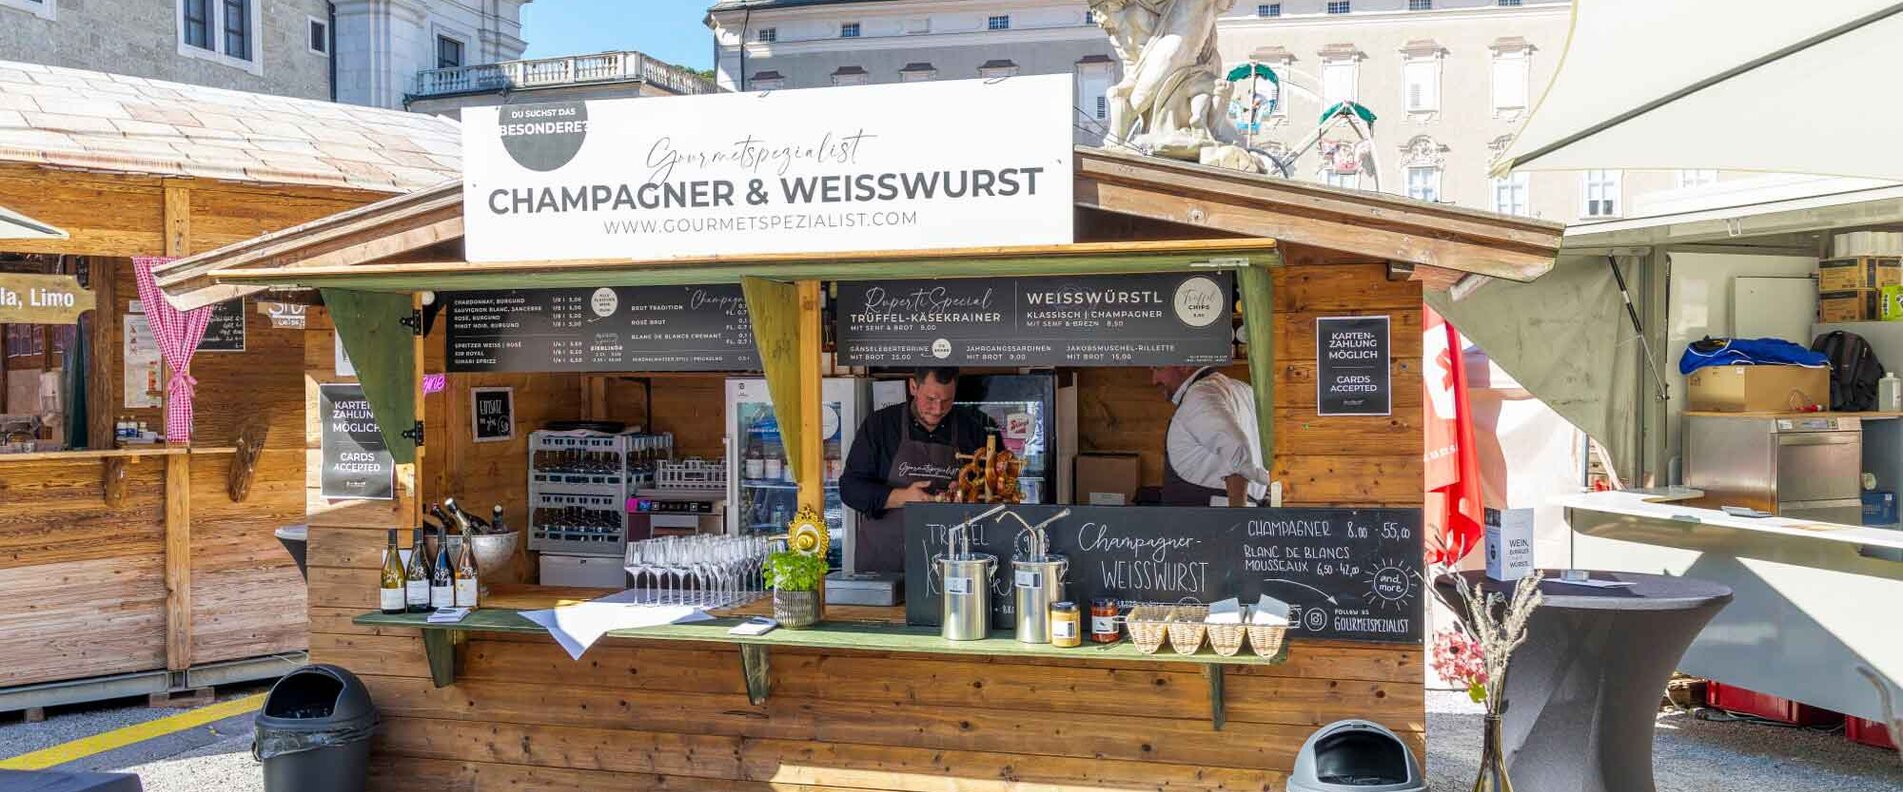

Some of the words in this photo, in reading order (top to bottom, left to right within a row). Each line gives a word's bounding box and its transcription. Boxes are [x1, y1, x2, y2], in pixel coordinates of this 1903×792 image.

[511, 111, 523, 119] DU
[525, 109, 556, 118] SUCHST
[558, 108, 576, 116] DAS
[499, 120, 591, 136] BESONDERE?
[647, 129, 878, 191] Gourmetspezialist
[489, 179, 733, 215] CHAMPAGNER
[746, 177, 769, 206] &
[781, 167, 1044, 204] WEISSWURST
[603, 211, 917, 234] WWW.GOURMETSPEZIALIST.COM
[31, 288, 74, 307] Limo
[1027, 289, 1163, 304] WEISSWÜRSTL
[850, 311, 1001, 323] TRÜFFEL-KÄSEKRAINER
[1026, 311, 1081, 319] KLASSISCH
[1091, 310, 1163, 318] CHAMPAGNER
[1332, 332, 1375, 340] KARTEN-
[1066, 344, 1175, 352] JAKOBSMUSCHEL-RILLETTE
[1329, 340, 1377, 348] ZAHLUNG
[1329, 350, 1378, 359] MÖGLICH
[1337, 375, 1370, 384] CARDS
[1330, 384, 1377, 392] ACCEPTED
[333, 410, 374, 419] ZAHLUN
[340, 452, 375, 461] CARDS
[333, 463, 381, 472] ACCEPTED
[1247, 520, 1332, 537] CHAMPAGNER
[1078, 522, 1202, 562] Champagner-
[1509, 539, 1529, 548] WEIN,
[1244, 544, 1280, 558] BLANC
[1286, 547, 1301, 558] DE
[1304, 546, 1350, 559] BLANCS
[1245, 559, 1309, 572] MOUSSEAUX
[1101, 560, 1208, 593] WEISSWURST
[1380, 574, 1400, 584] and
[1379, 584, 1403, 592] more
[1334, 617, 1409, 633] GOURMETSPEZIALIST
